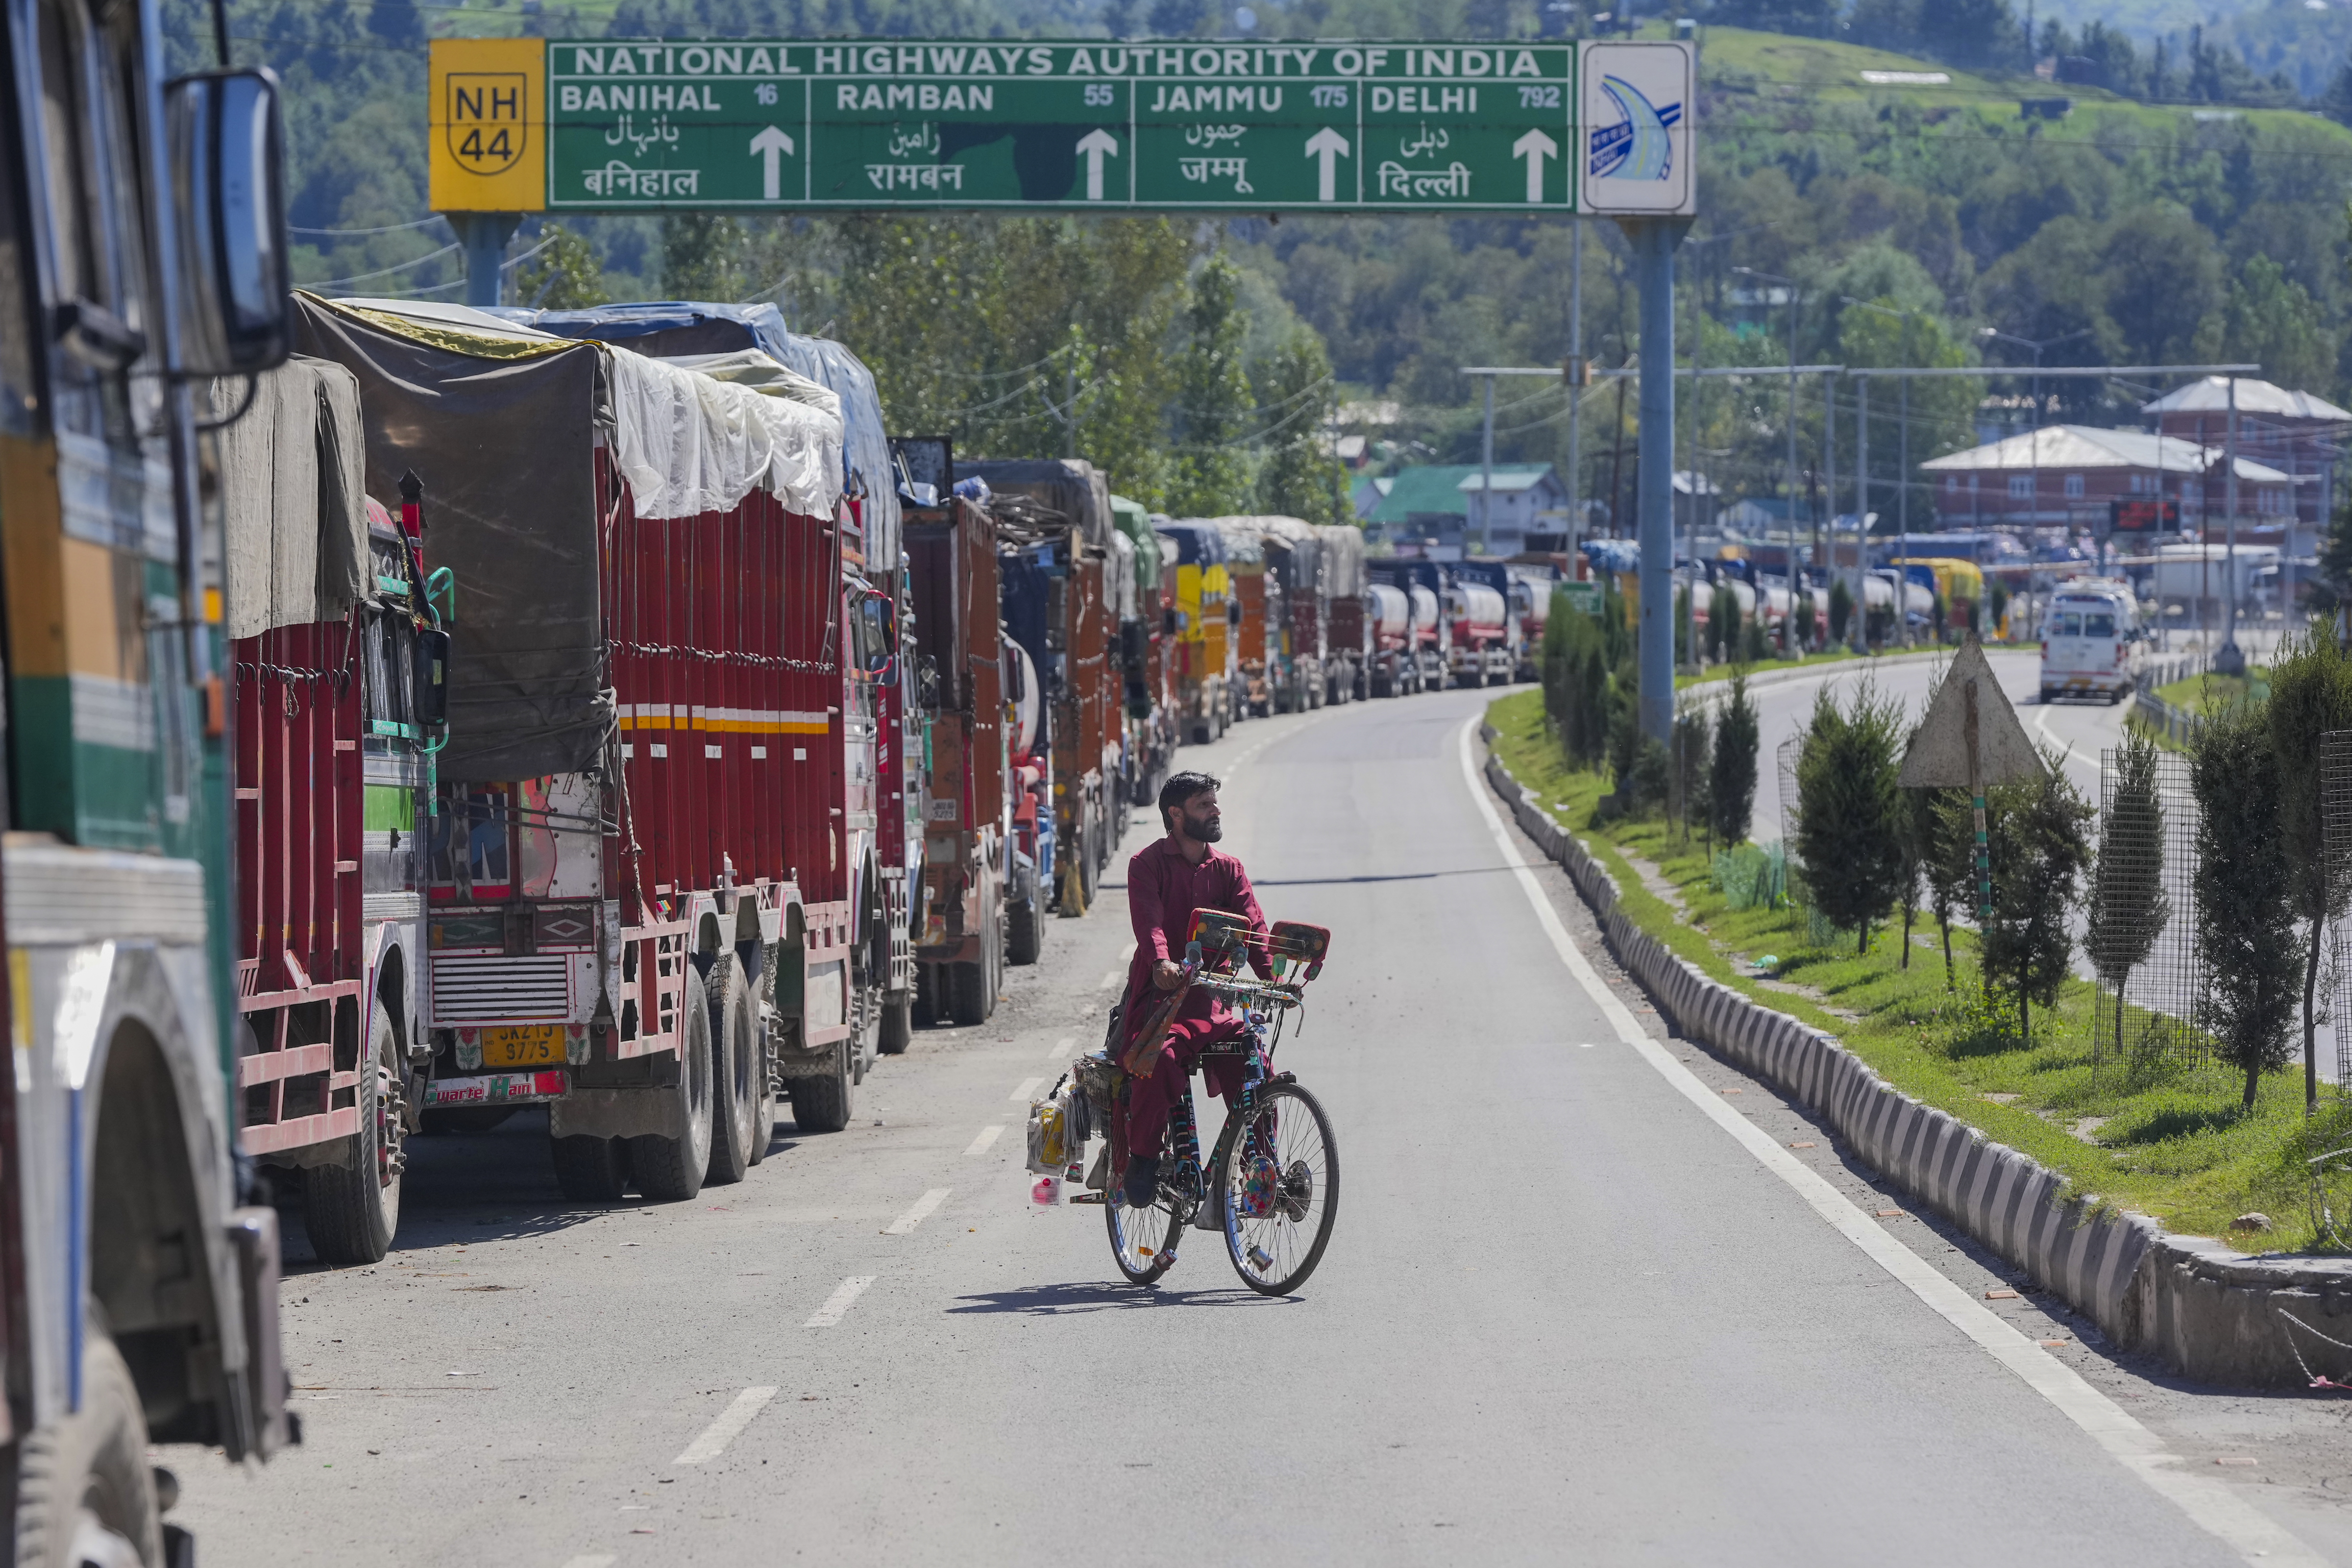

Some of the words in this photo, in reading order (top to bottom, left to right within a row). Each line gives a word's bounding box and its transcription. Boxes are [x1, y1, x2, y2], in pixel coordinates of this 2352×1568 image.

[575, 47, 801, 74] NATIONAL
[815, 47, 1054, 74] HIGHWAYS
[1067, 48, 1318, 75] AUTHORITY
[1333, 49, 1388, 76] OF
[1405, 49, 1542, 77] INDIA
[457, 87, 516, 120] NH
[561, 85, 721, 111] BANIHAL
[754, 83, 778, 105] 16
[837, 84, 993, 110] RAMBAN
[1084, 84, 1114, 106] 55
[1151, 86, 1282, 112] JAMMU
[1310, 85, 1348, 107] 175
[1372, 86, 1477, 113] DELHI
[1517, 86, 1560, 108] 792
[460, 128, 513, 161] 44
[582, 160, 700, 196] बनिहाल
[864, 164, 965, 190] रामबन
[1178, 157, 1254, 193] जम्मू
[1376, 161, 1471, 197] दिल्ली
[375, 721, 397, 734] Royal
[507, 1041, 549, 1060] 9775
[489, 1076, 532, 1097] Hain
